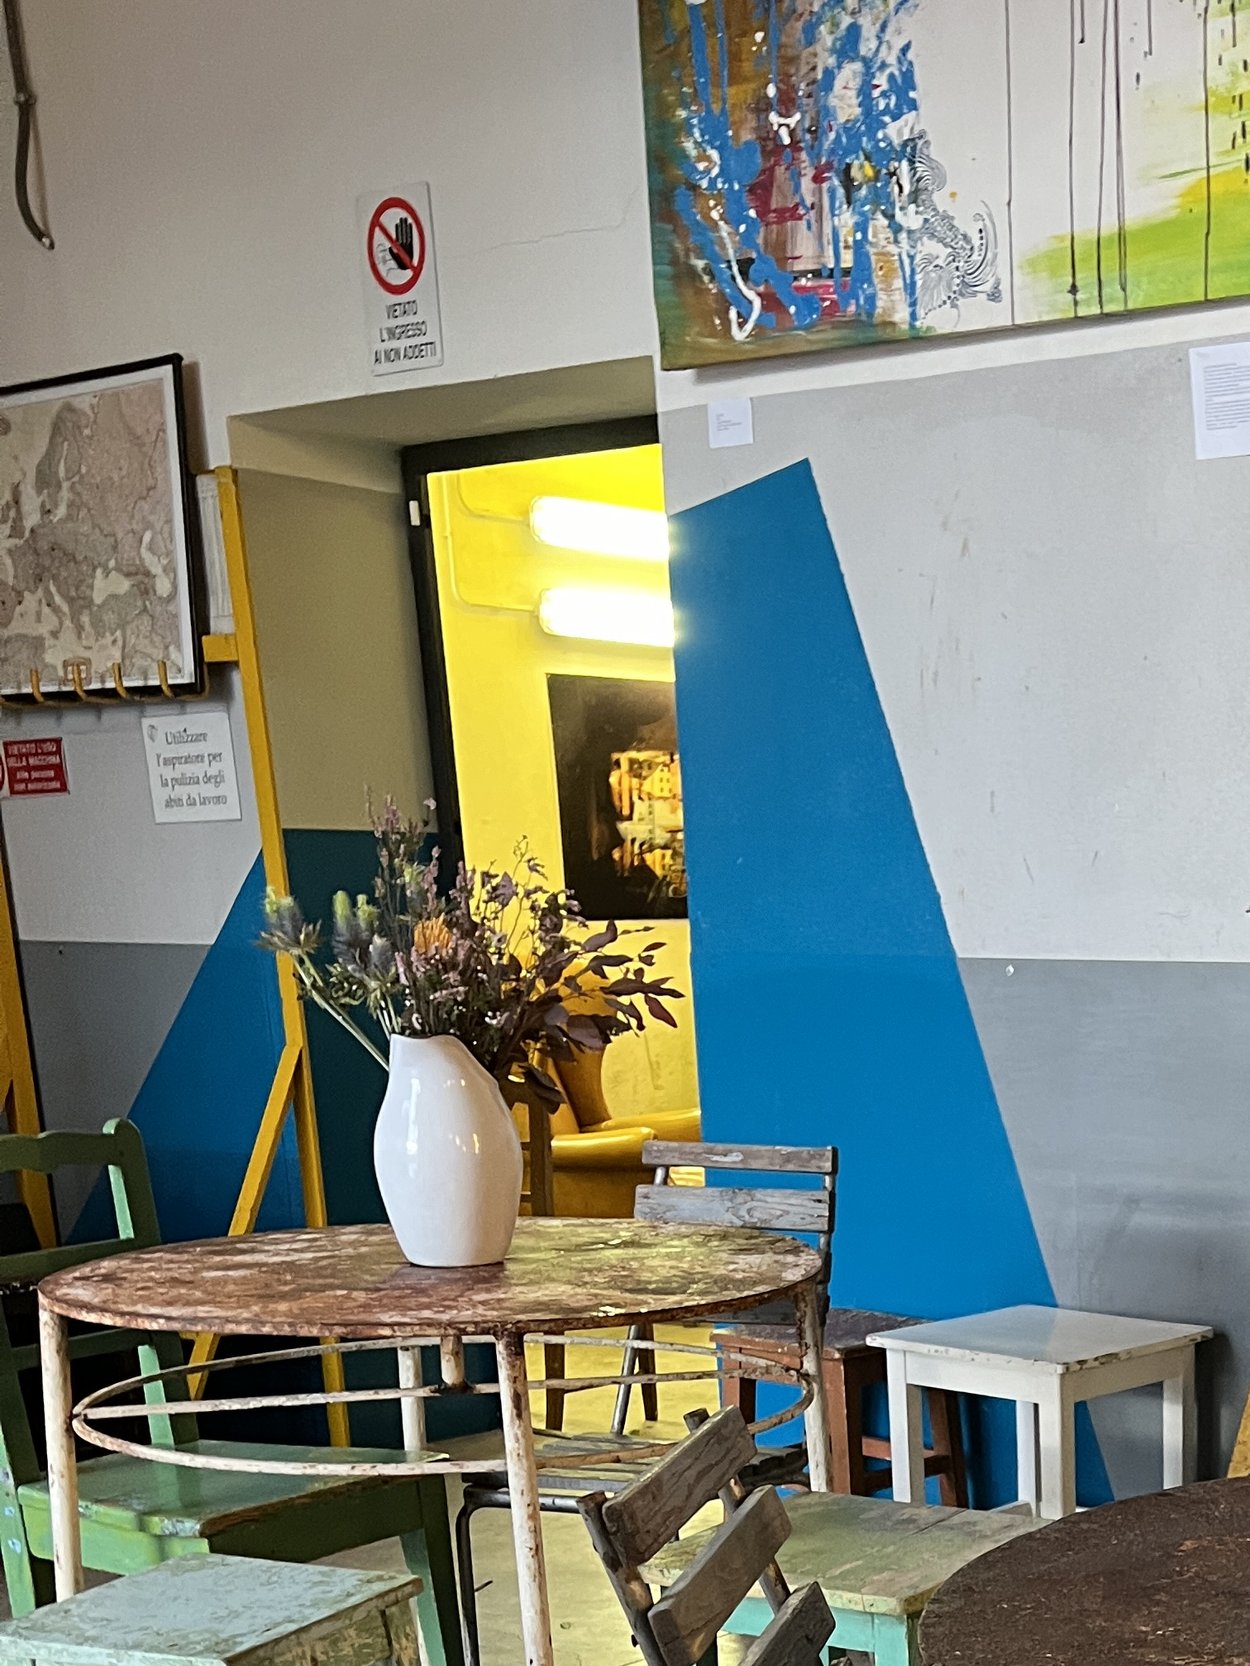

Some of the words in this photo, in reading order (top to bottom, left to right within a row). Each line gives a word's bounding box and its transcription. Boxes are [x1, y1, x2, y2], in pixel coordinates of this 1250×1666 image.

[374, 349, 382, 365] AI
[383, 347, 401, 363] NON
[403, 341, 437, 360] ADDETTI
[165, 730, 208, 745] Utilizzare
[208, 752, 222, 768] per
[160, 773, 169, 788] la
[171, 772, 200, 792] pulizia
[202, 769, 225, 788] degli
[186, 793, 197, 807] da
[198, 792, 227, 806] lavoro
